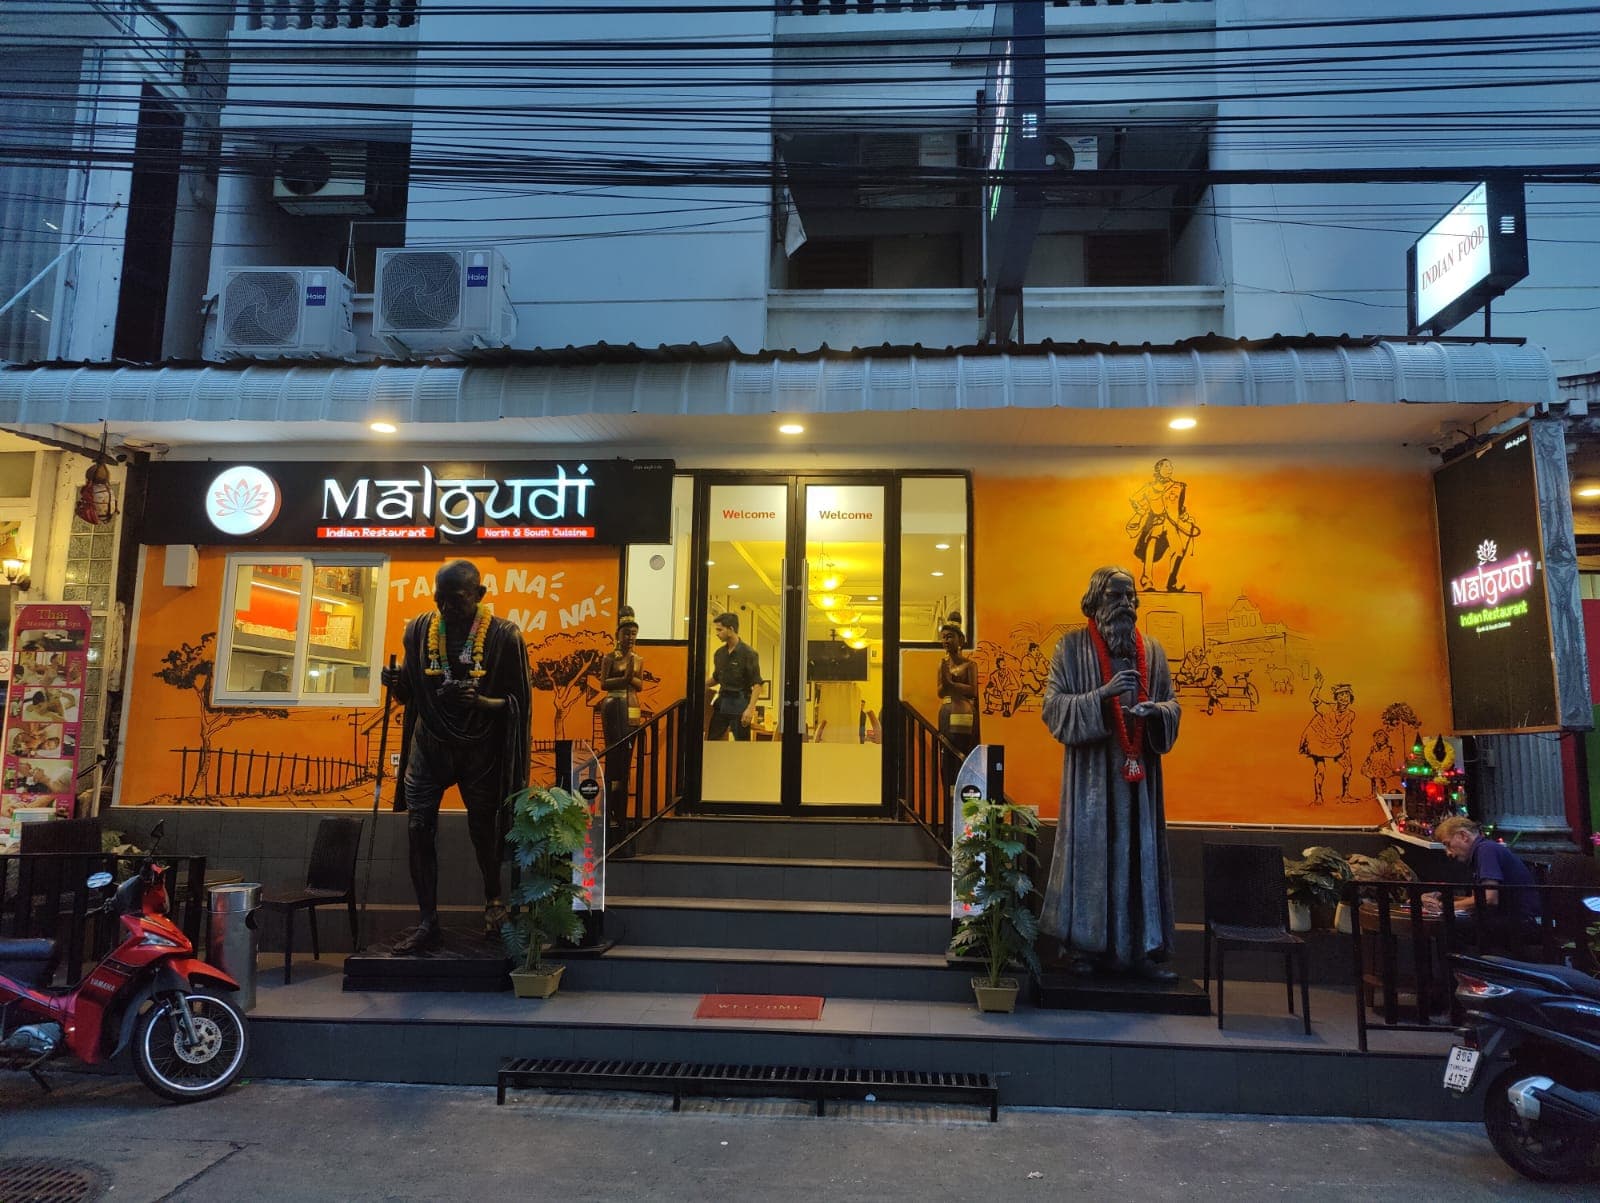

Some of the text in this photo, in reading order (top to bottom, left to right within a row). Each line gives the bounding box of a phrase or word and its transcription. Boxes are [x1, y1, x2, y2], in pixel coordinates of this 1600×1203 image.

[1422, 225, 1485, 290] INDIAN FOOD
[321, 464, 595, 535] Malgudi
[723, 510, 776, 519] Welcome
[819, 510, 873, 520] Welcome
[326, 527, 427, 537] Indian Restaurant
[484, 529, 588, 537] North & South Cuisine
[1451, 551, 1532, 606] Malgudi
[36, 609, 69, 620] Thai
[1460, 612, 1482, 627] Indian
[1482, 600, 1528, 622] Restaurant
[90, 978, 116, 992] YAMAHA
[1448, 1072, 1468, 1085] 4175
